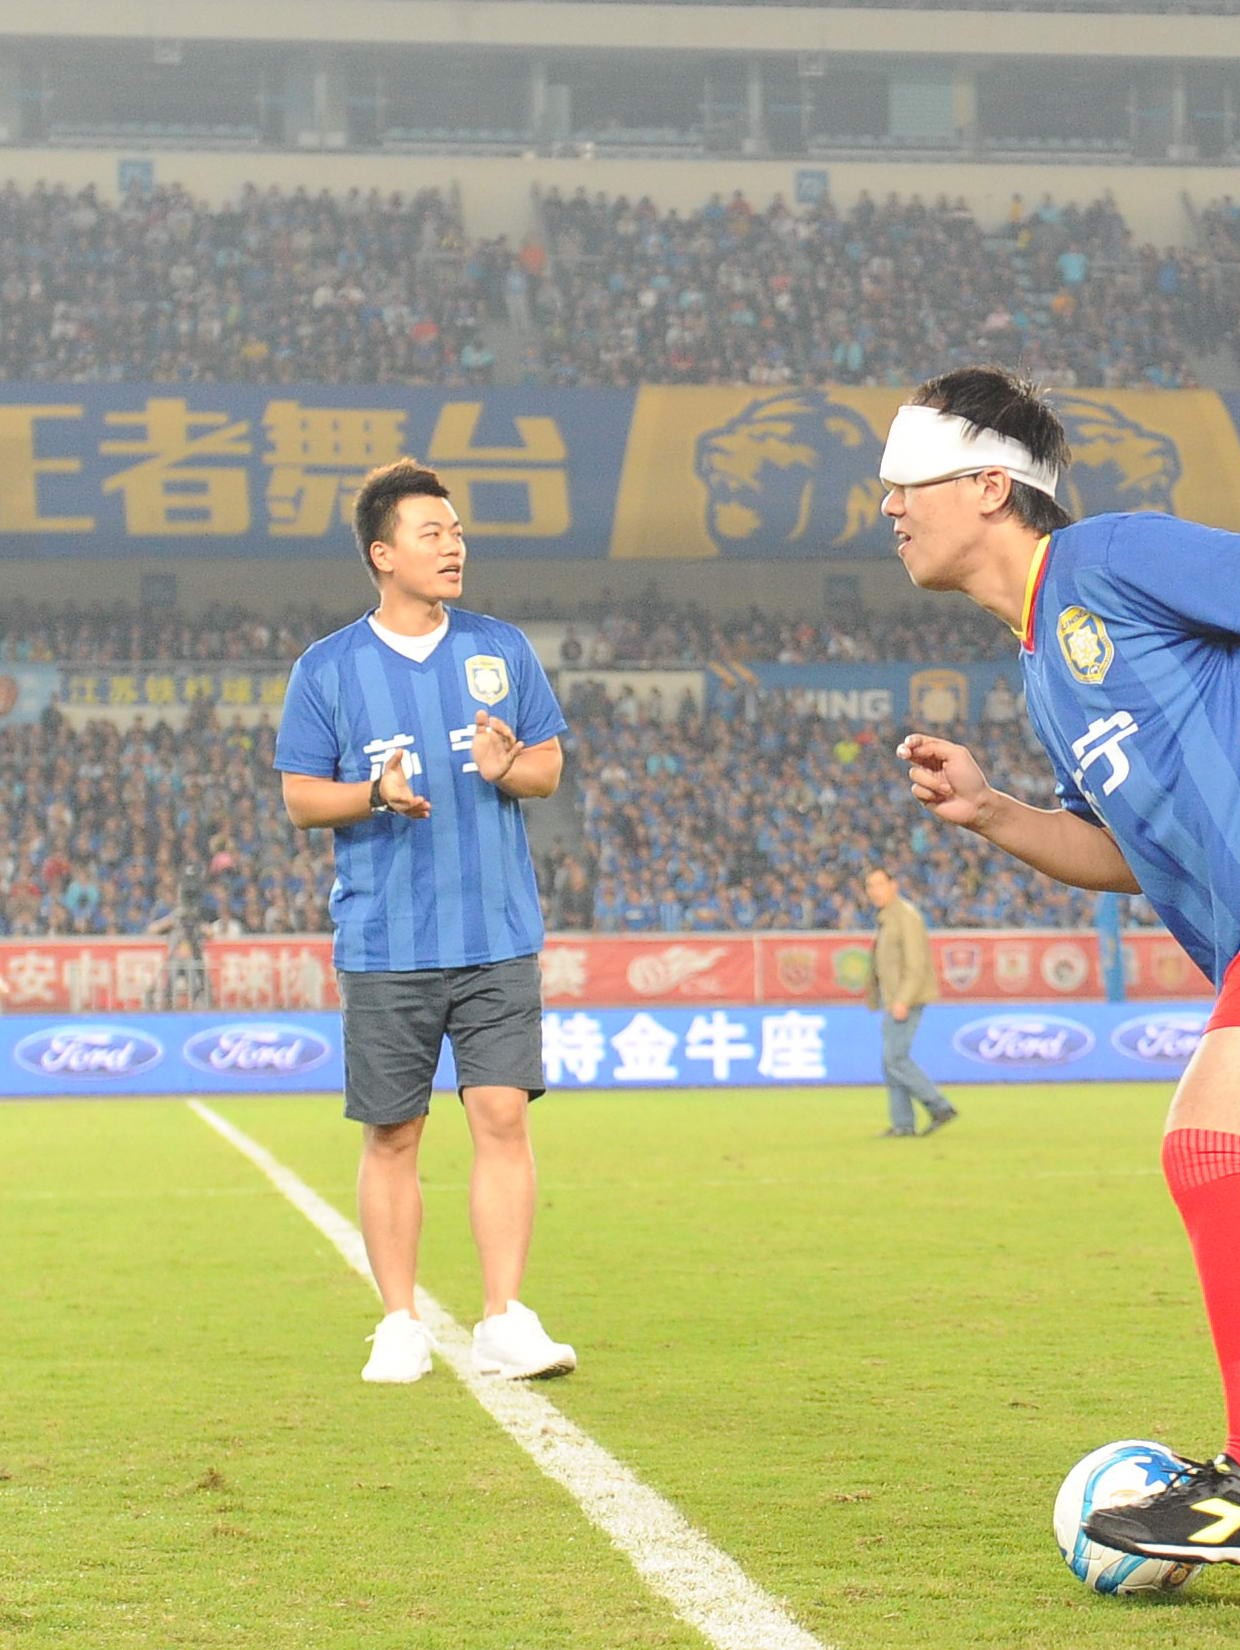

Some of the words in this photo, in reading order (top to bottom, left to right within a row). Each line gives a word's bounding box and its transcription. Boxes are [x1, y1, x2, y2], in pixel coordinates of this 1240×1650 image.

[41, 1031, 135, 1072] Ford
[209, 1030, 304, 1071] Ford
[978, 1022, 1068, 1060] Ford
